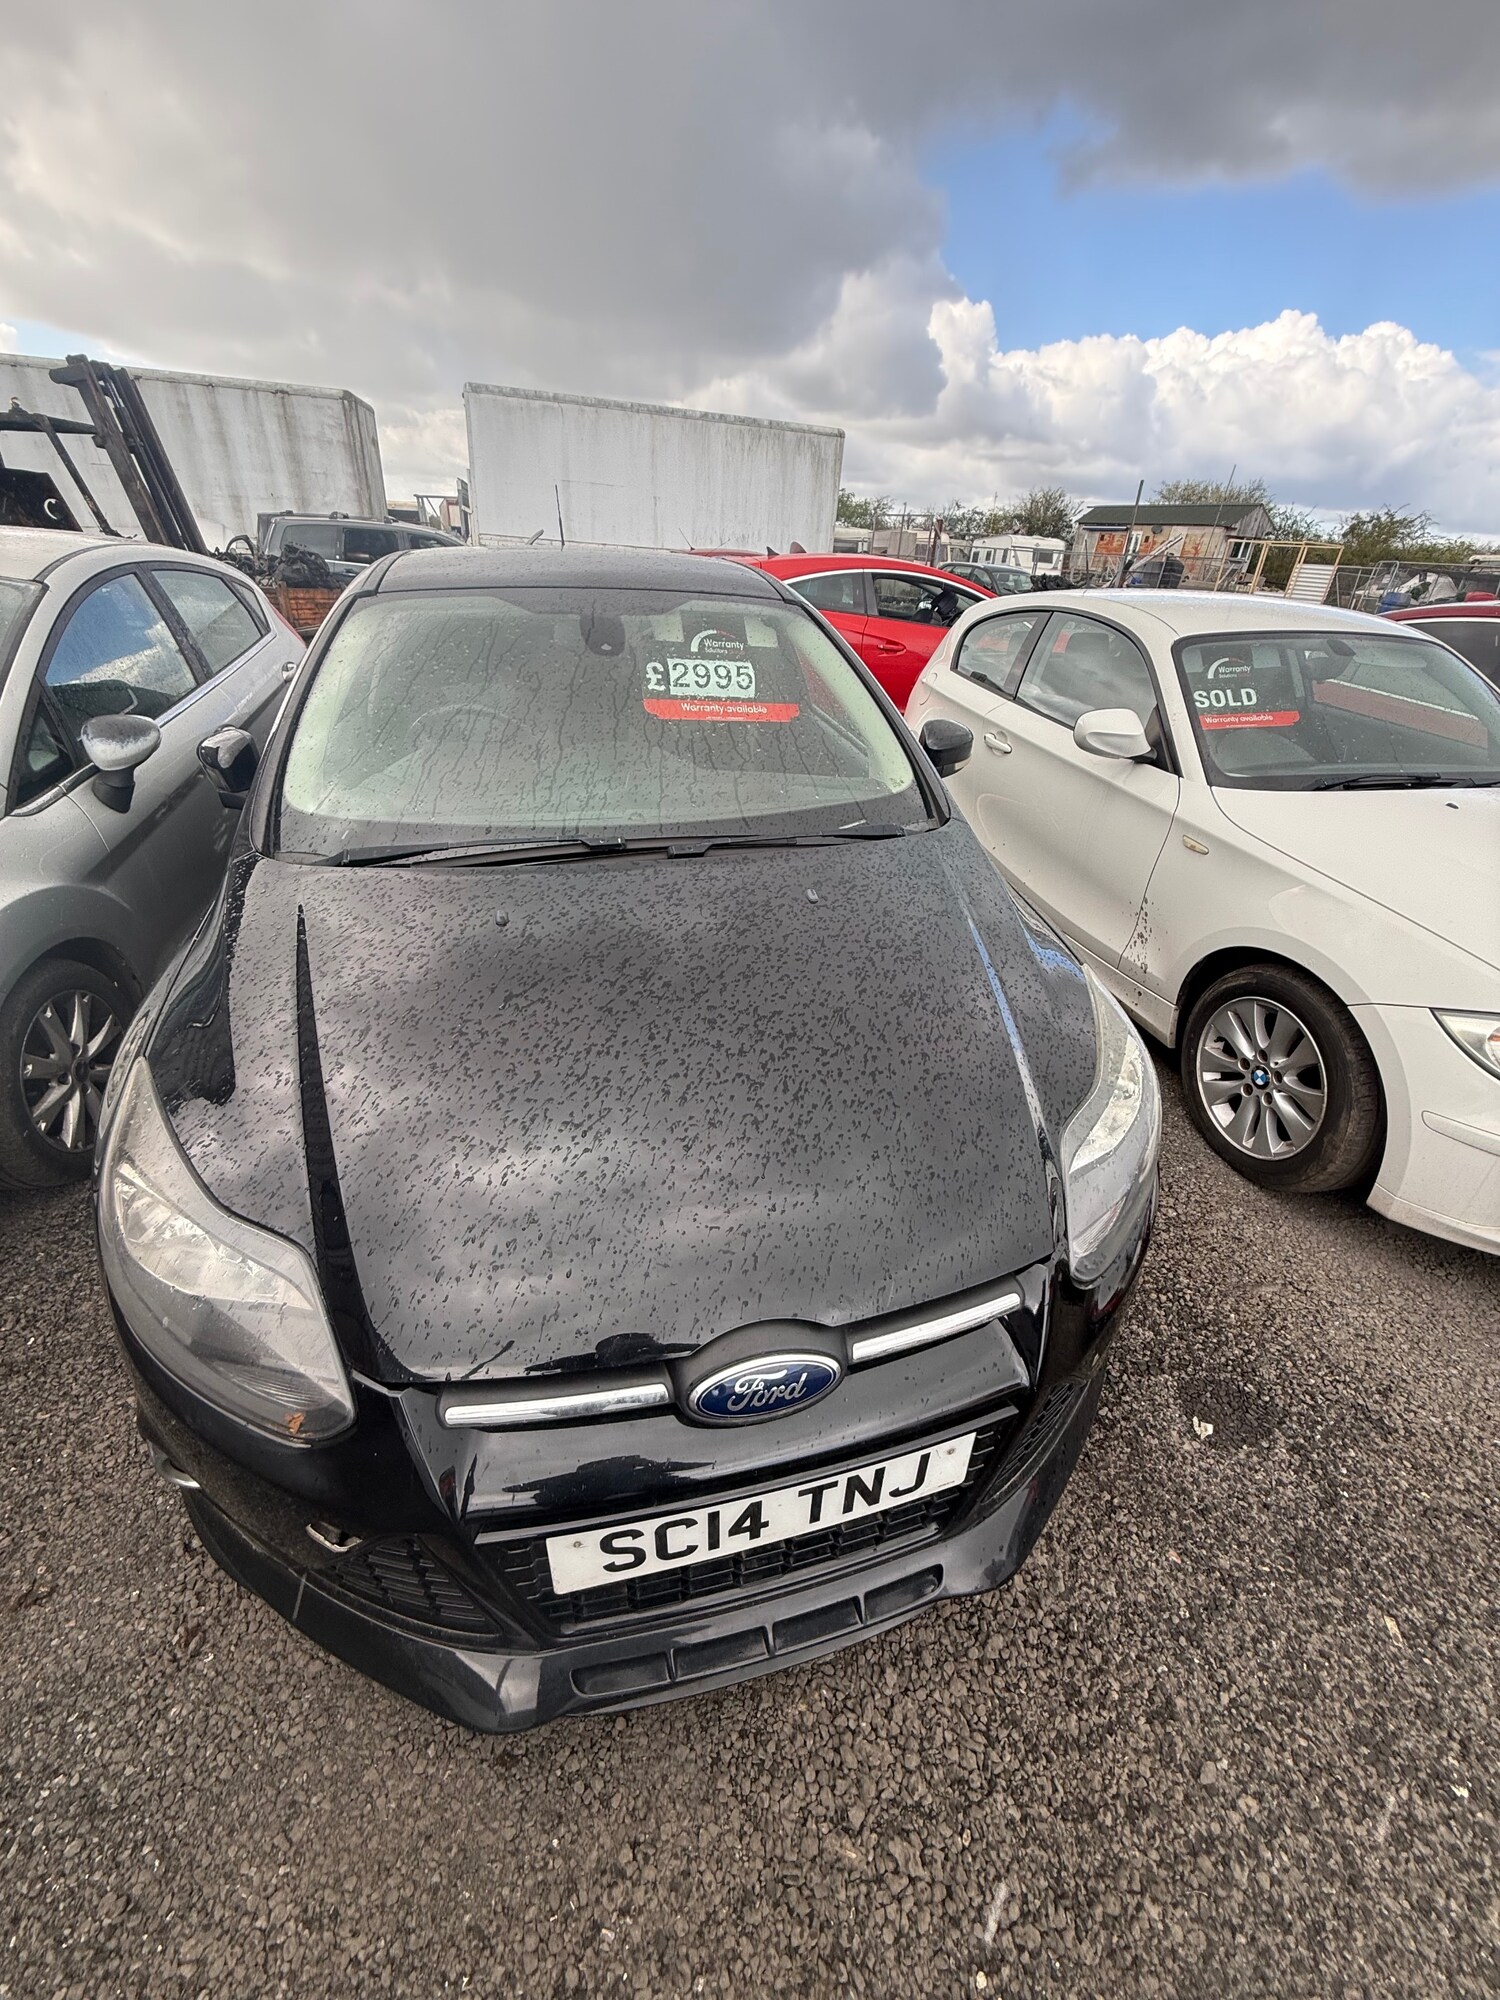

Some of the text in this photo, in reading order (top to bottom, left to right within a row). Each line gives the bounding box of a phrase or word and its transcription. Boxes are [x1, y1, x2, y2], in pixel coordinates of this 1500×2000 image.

[703, 638, 744, 651] Warranty
[645, 661, 753, 691] £2995
[1218, 665, 1251, 674] Warranty
[1193, 687, 1257, 708] SOLD
[681, 703, 767, 714] Warranty available
[1204, 714, 1273, 724] Warranty available
[727, 1369, 808, 1412] Ford
[599, 1452, 931, 1573] SC14 TNJ
